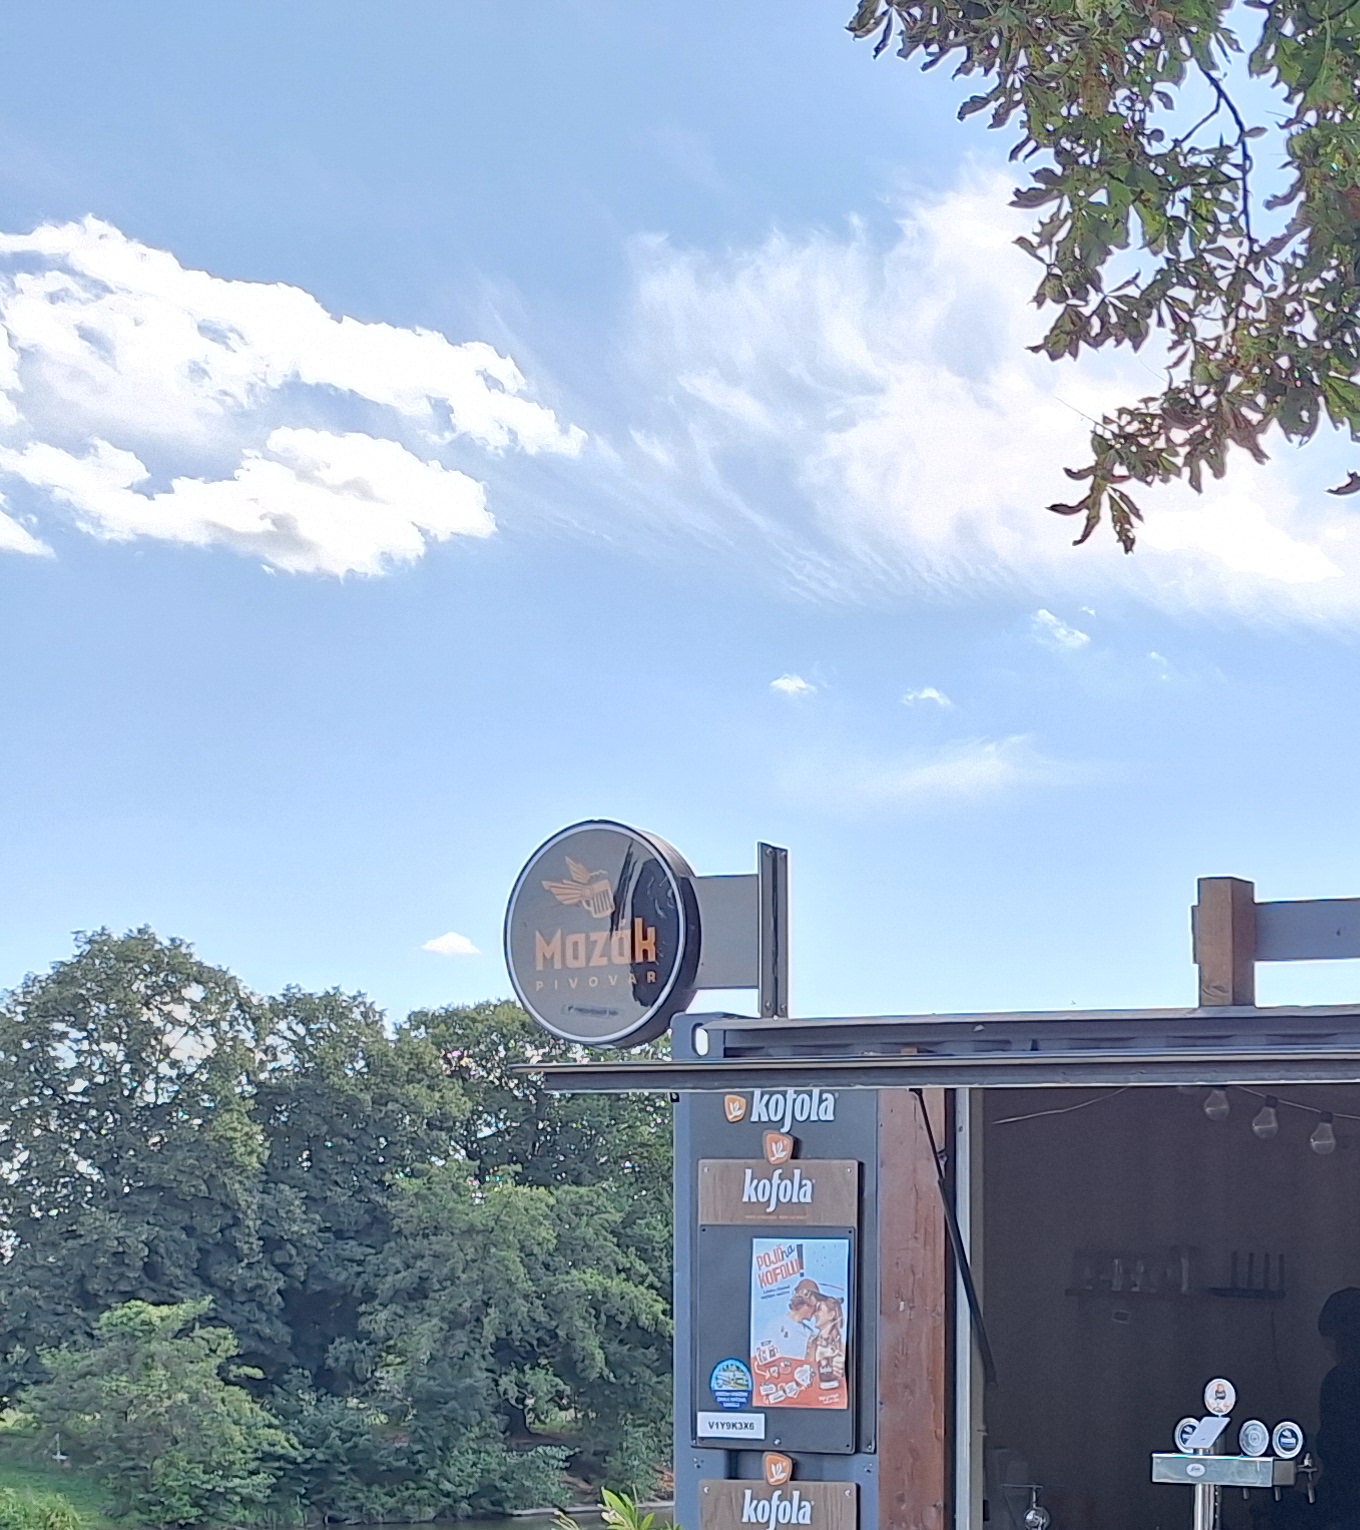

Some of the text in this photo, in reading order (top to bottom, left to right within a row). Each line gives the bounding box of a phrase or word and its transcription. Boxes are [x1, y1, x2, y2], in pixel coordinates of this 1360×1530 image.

[535, 917, 657, 971] Mazák
[535, 971, 657, 992] PIVOVAR
[750, 1090, 835, 1133] kofola
[742, 1168, 813, 1213] kofola
[708, 1421, 755, 1431] V1Y9K3X6
